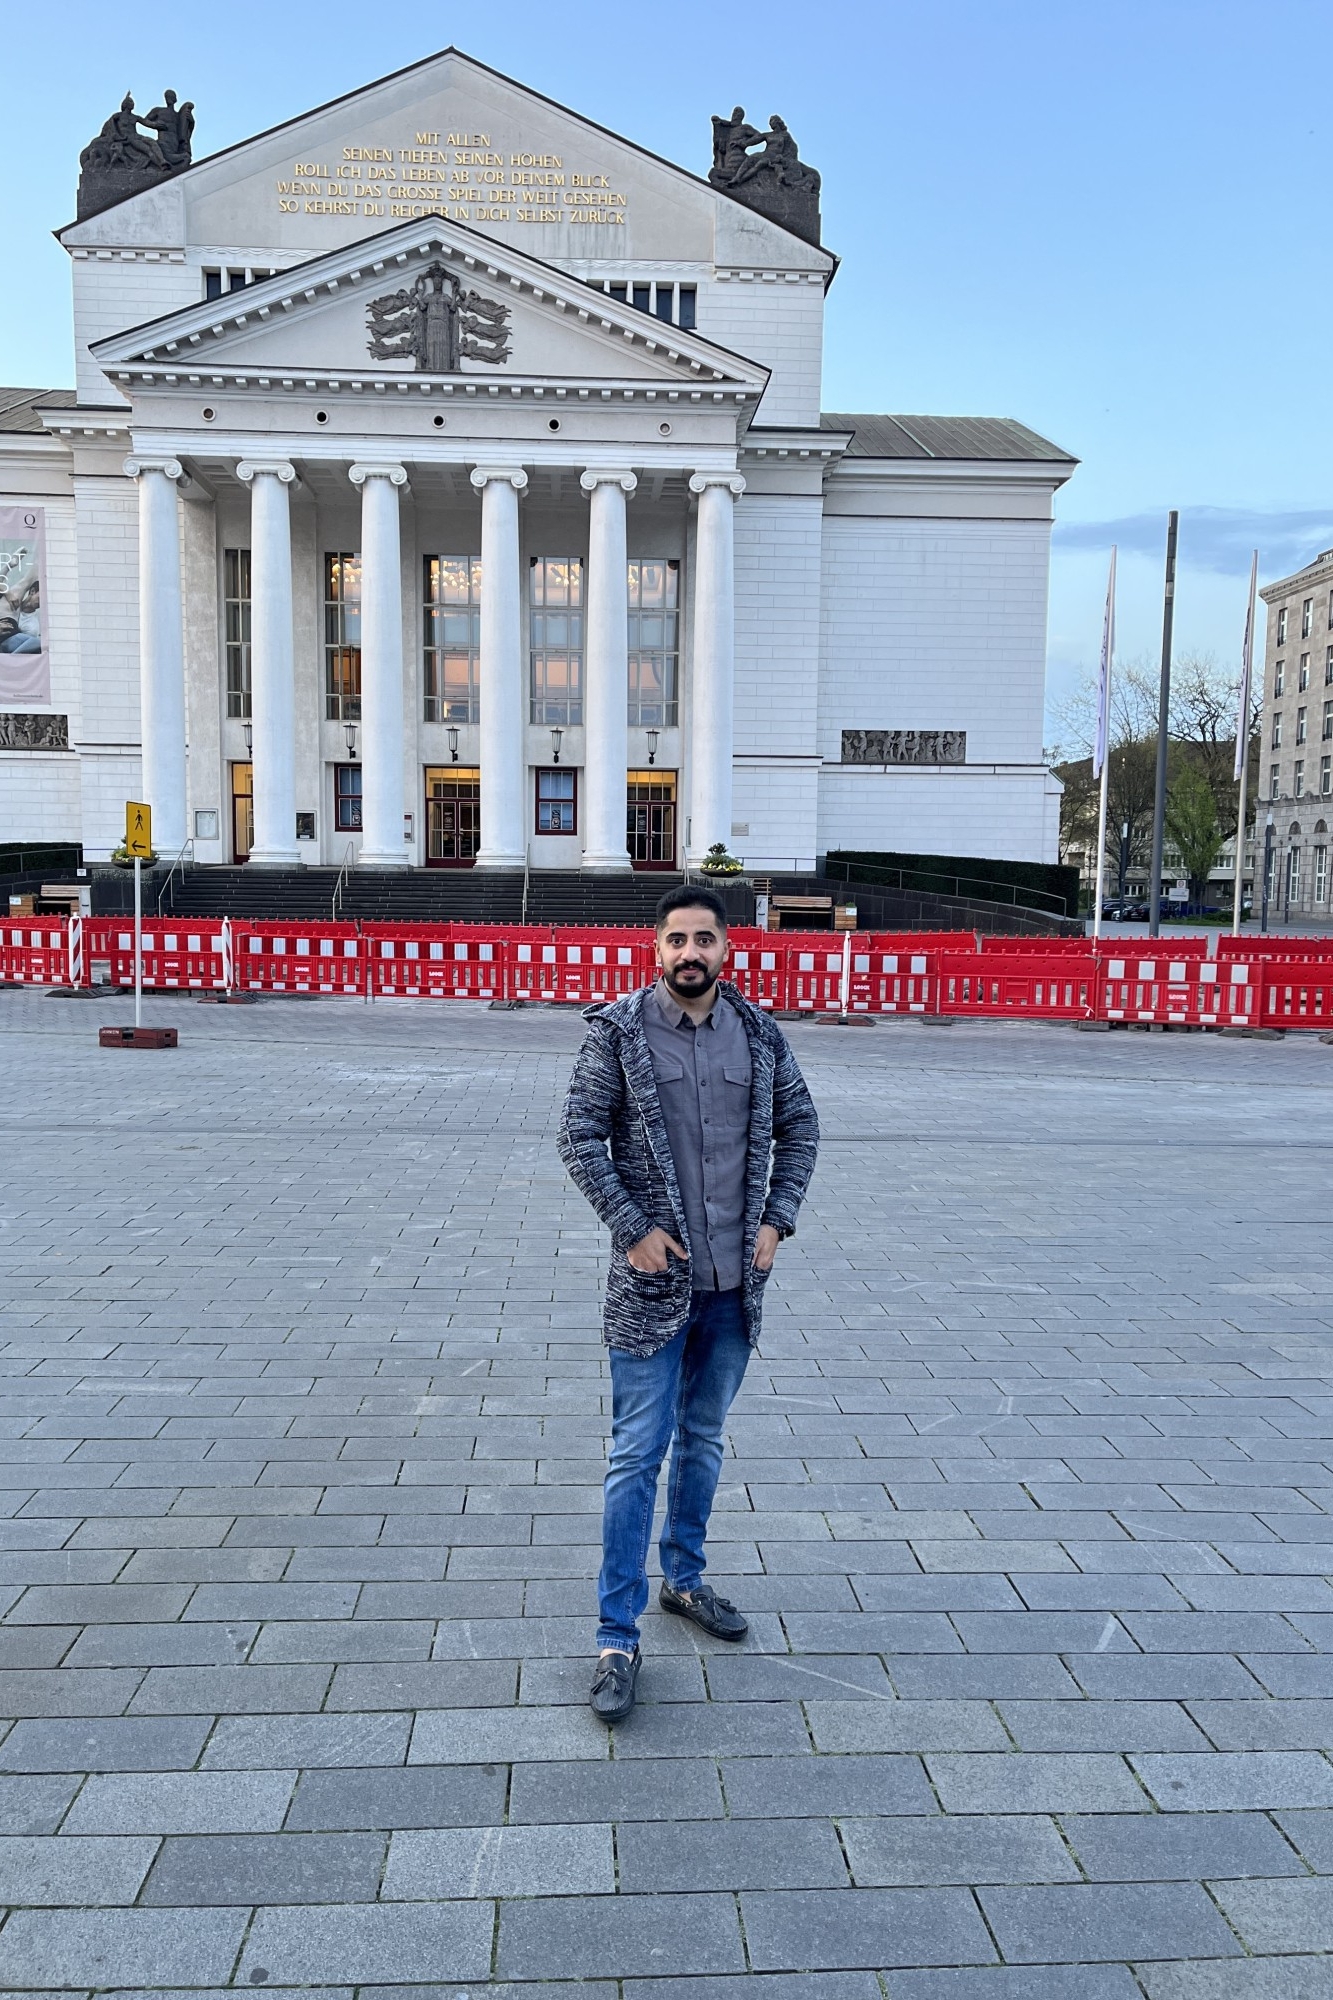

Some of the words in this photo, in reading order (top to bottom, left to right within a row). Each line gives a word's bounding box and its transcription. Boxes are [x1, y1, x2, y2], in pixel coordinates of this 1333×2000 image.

[416, 132, 440, 145] MIT
[447, 133, 491, 147] ALLEN
[343, 148, 393, 162] SEINEN
[399, 150, 448, 164] TIEFEN
[454, 152, 504, 166] SEINEN
[295, 164, 330, 178] ROLL
[336, 166, 361, 179] ICH
[368, 167, 396, 180] DAS
[402, 169, 445, 182] LEBEN
[450, 170, 469, 183] AB
[475, 171, 504, 184] VOR
[511, 173, 565, 186] DEINEM
[572, 175, 610, 188] BLICK
[277, 181, 321, 195] WENN
[328, 183, 348, 196] DU
[354, 184, 382, 198] DAS
[388, 186, 443, 200] GROSSE
[448, 188, 484, 202] SPIEL
[489, 190, 516, 203] DER
[522, 191, 558, 204] WELT
[563, 192, 627, 206] GESEHEN
[279, 200, 299, 212] SO
[305, 201, 359, 215] KEHRST
[364, 203, 385, 216] DU
[390, 205, 449, 218] REICHER
[455, 207, 469, 220] IN
[476, 208, 510, 221] DICH
[517, 209, 564, 223] SELBST
[570, 208, 625, 224] ZURÜCK
